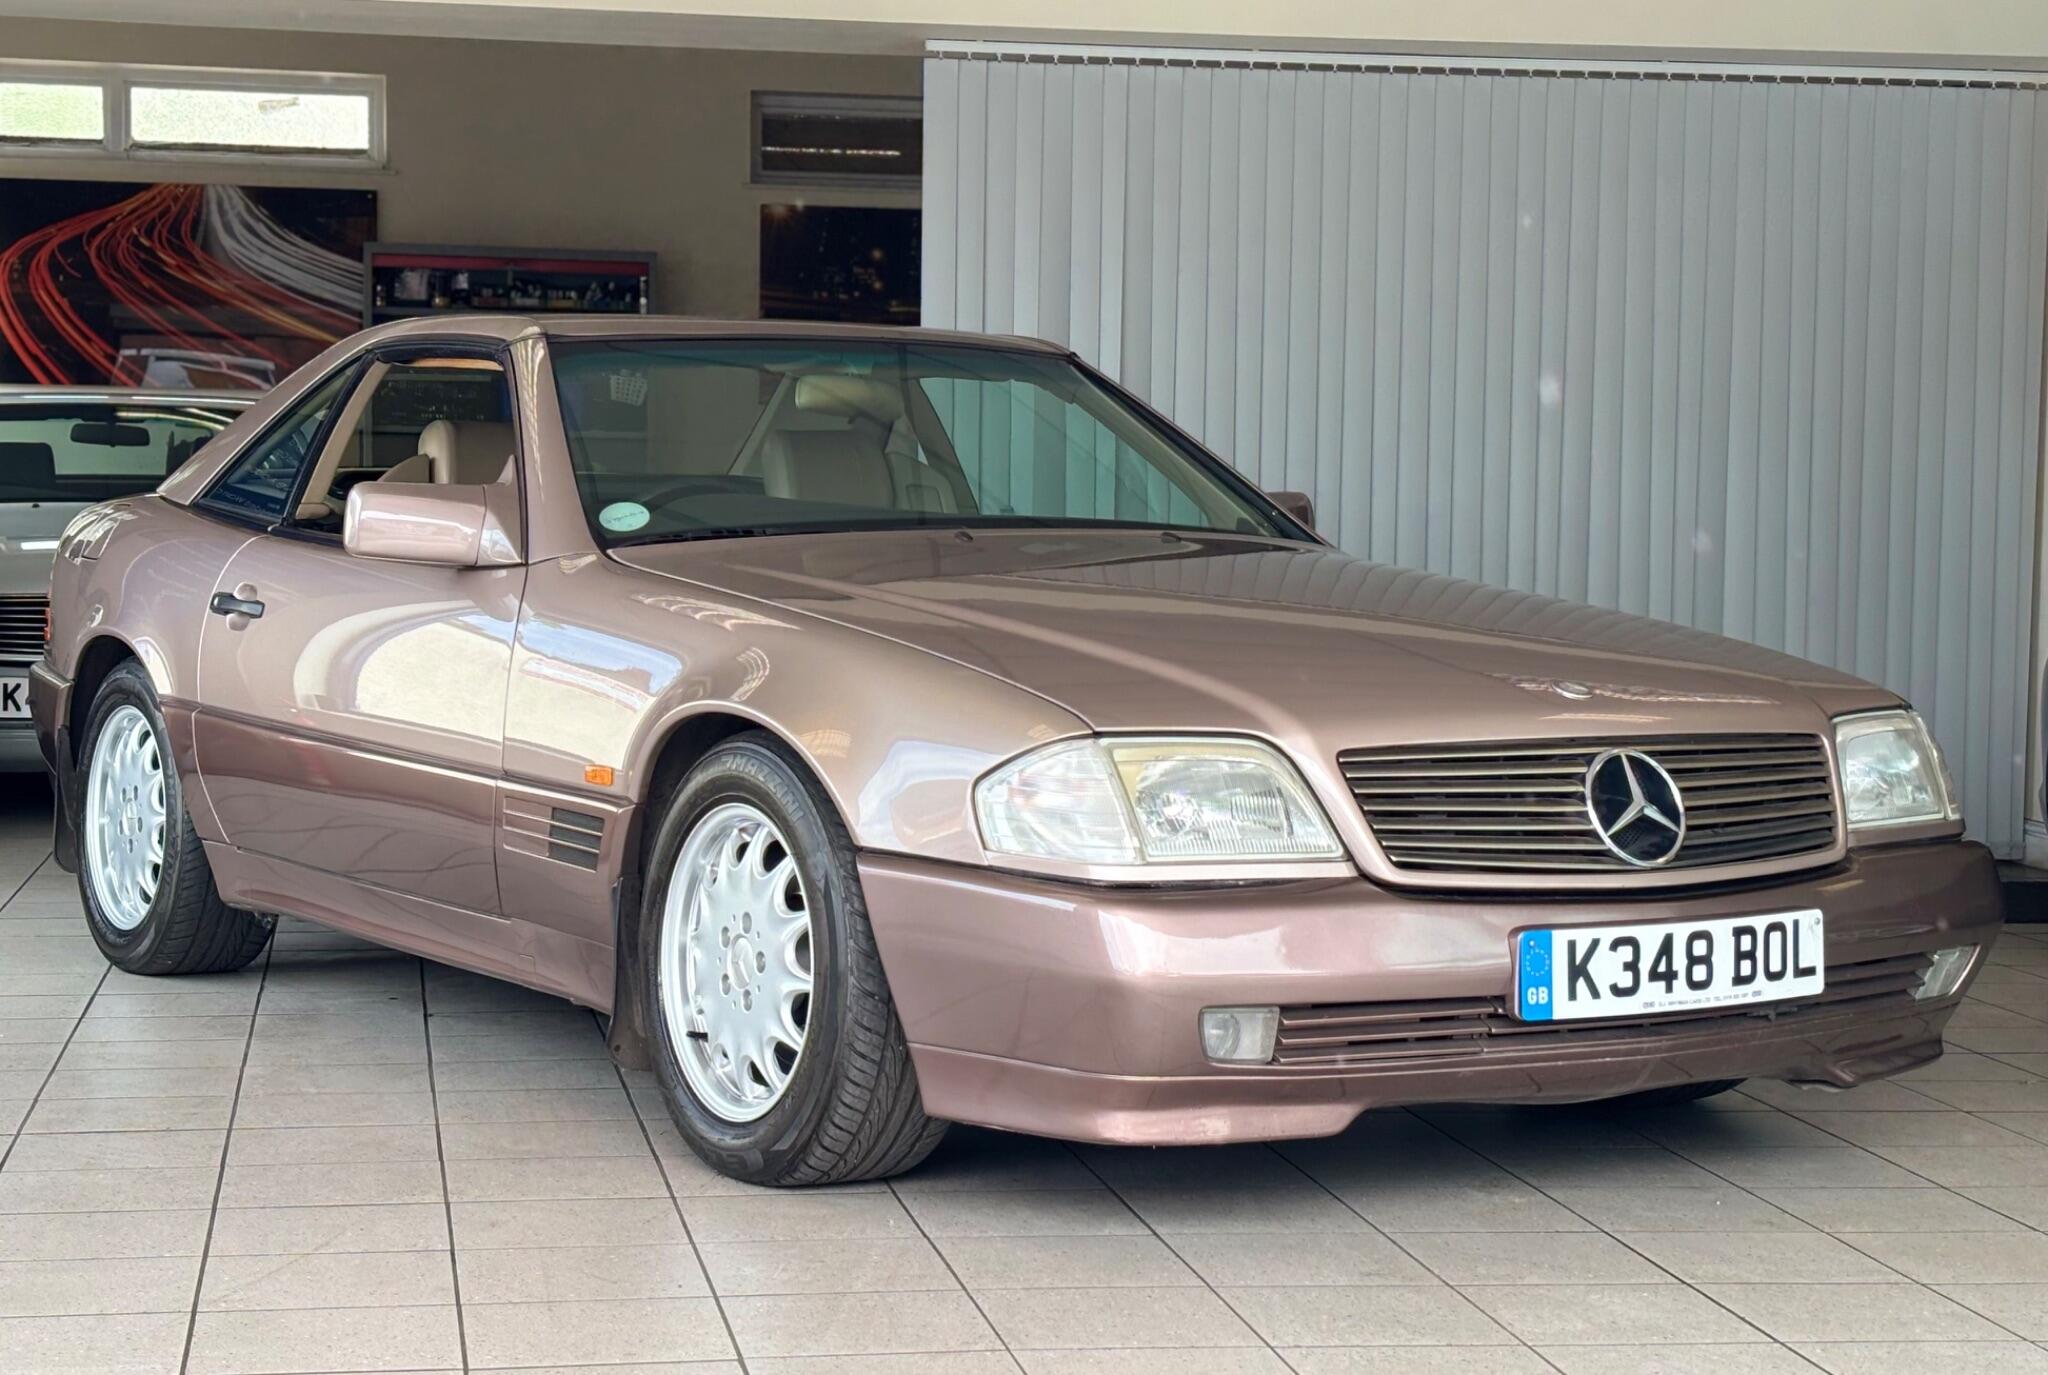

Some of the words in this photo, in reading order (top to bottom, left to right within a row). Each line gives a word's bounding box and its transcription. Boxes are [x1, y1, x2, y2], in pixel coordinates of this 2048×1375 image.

[1567, 933, 1713, 1001] K348
[1732, 919, 1816, 987] BOL
[1527, 986, 1549, 1005] GB
